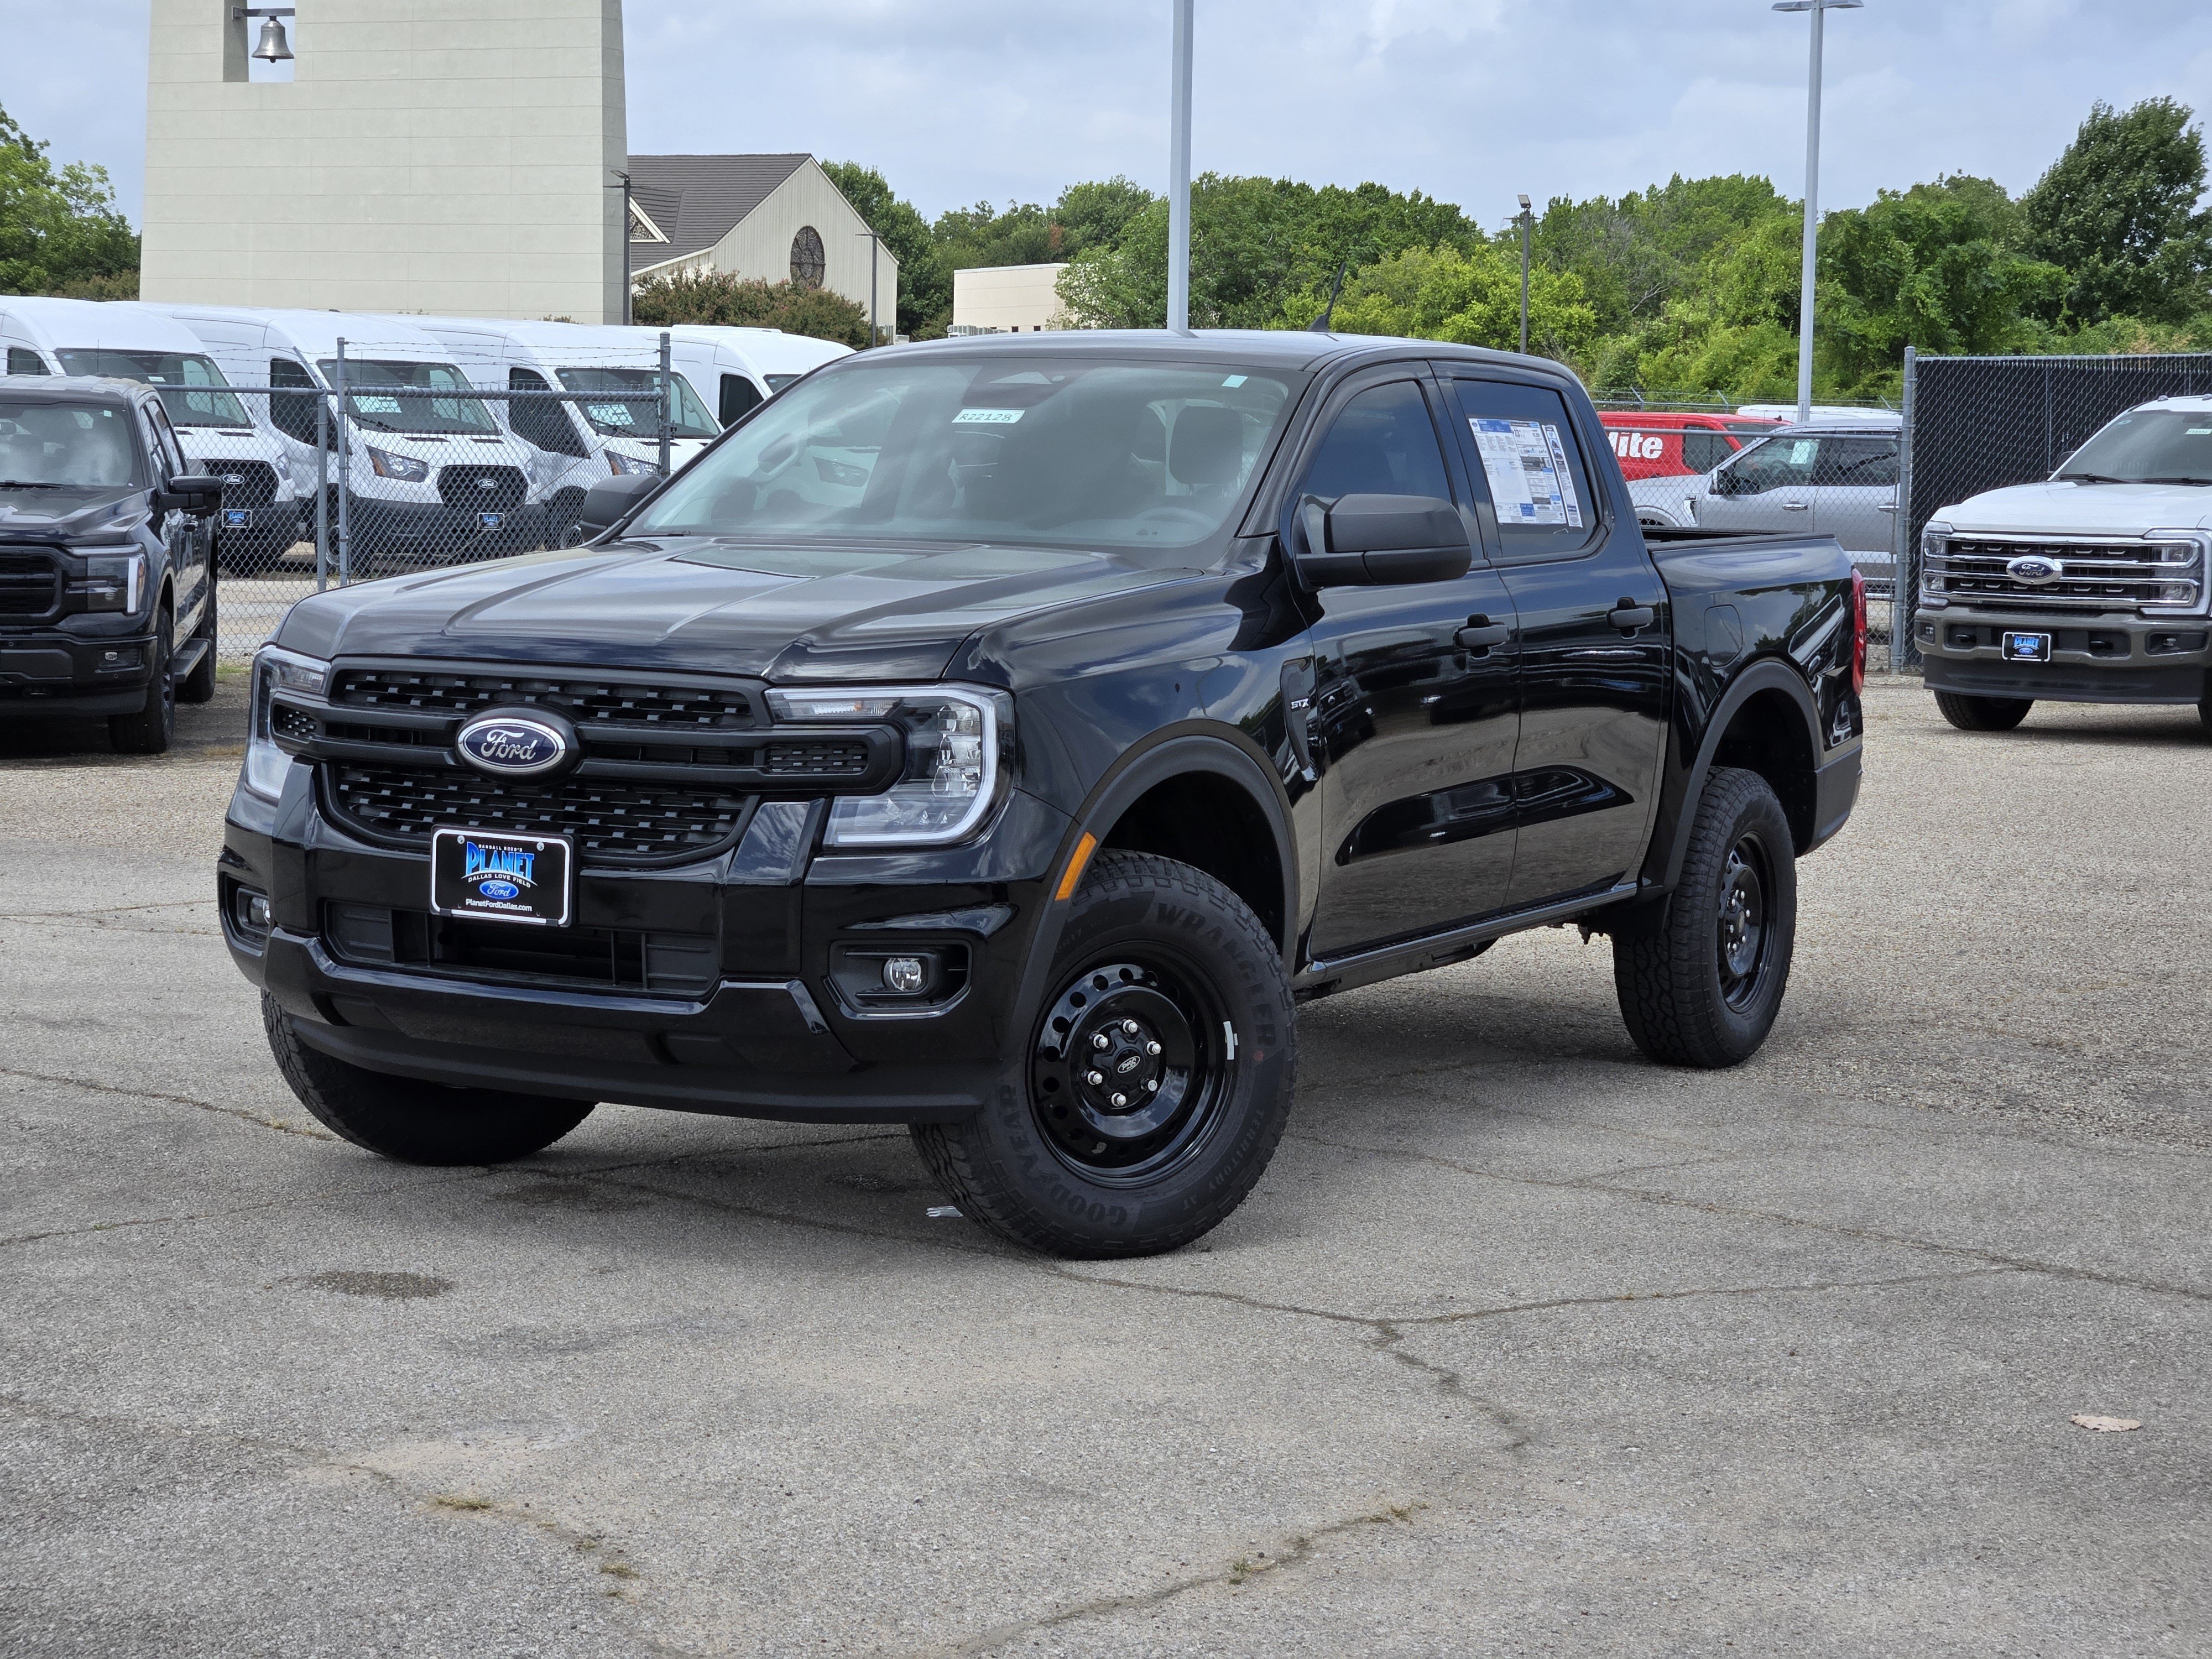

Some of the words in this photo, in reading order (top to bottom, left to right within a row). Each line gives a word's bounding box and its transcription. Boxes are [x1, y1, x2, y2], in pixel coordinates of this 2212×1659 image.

[958, 413, 1013, 421] R22128
[2018, 563, 2045, 576] Ford
[480, 729, 538, 760] Ford
[465, 841, 535, 881] PLANET
[468, 873, 492, 883] DALLAS
[513, 877, 531, 888] FIELD
[487, 883, 512, 897] Ford
[466, 898, 533, 912] PlanetFordDallas.com
[1156, 902, 1277, 1046] WRANGLER
[1209, 1109, 1265, 1193] TERRITORY
